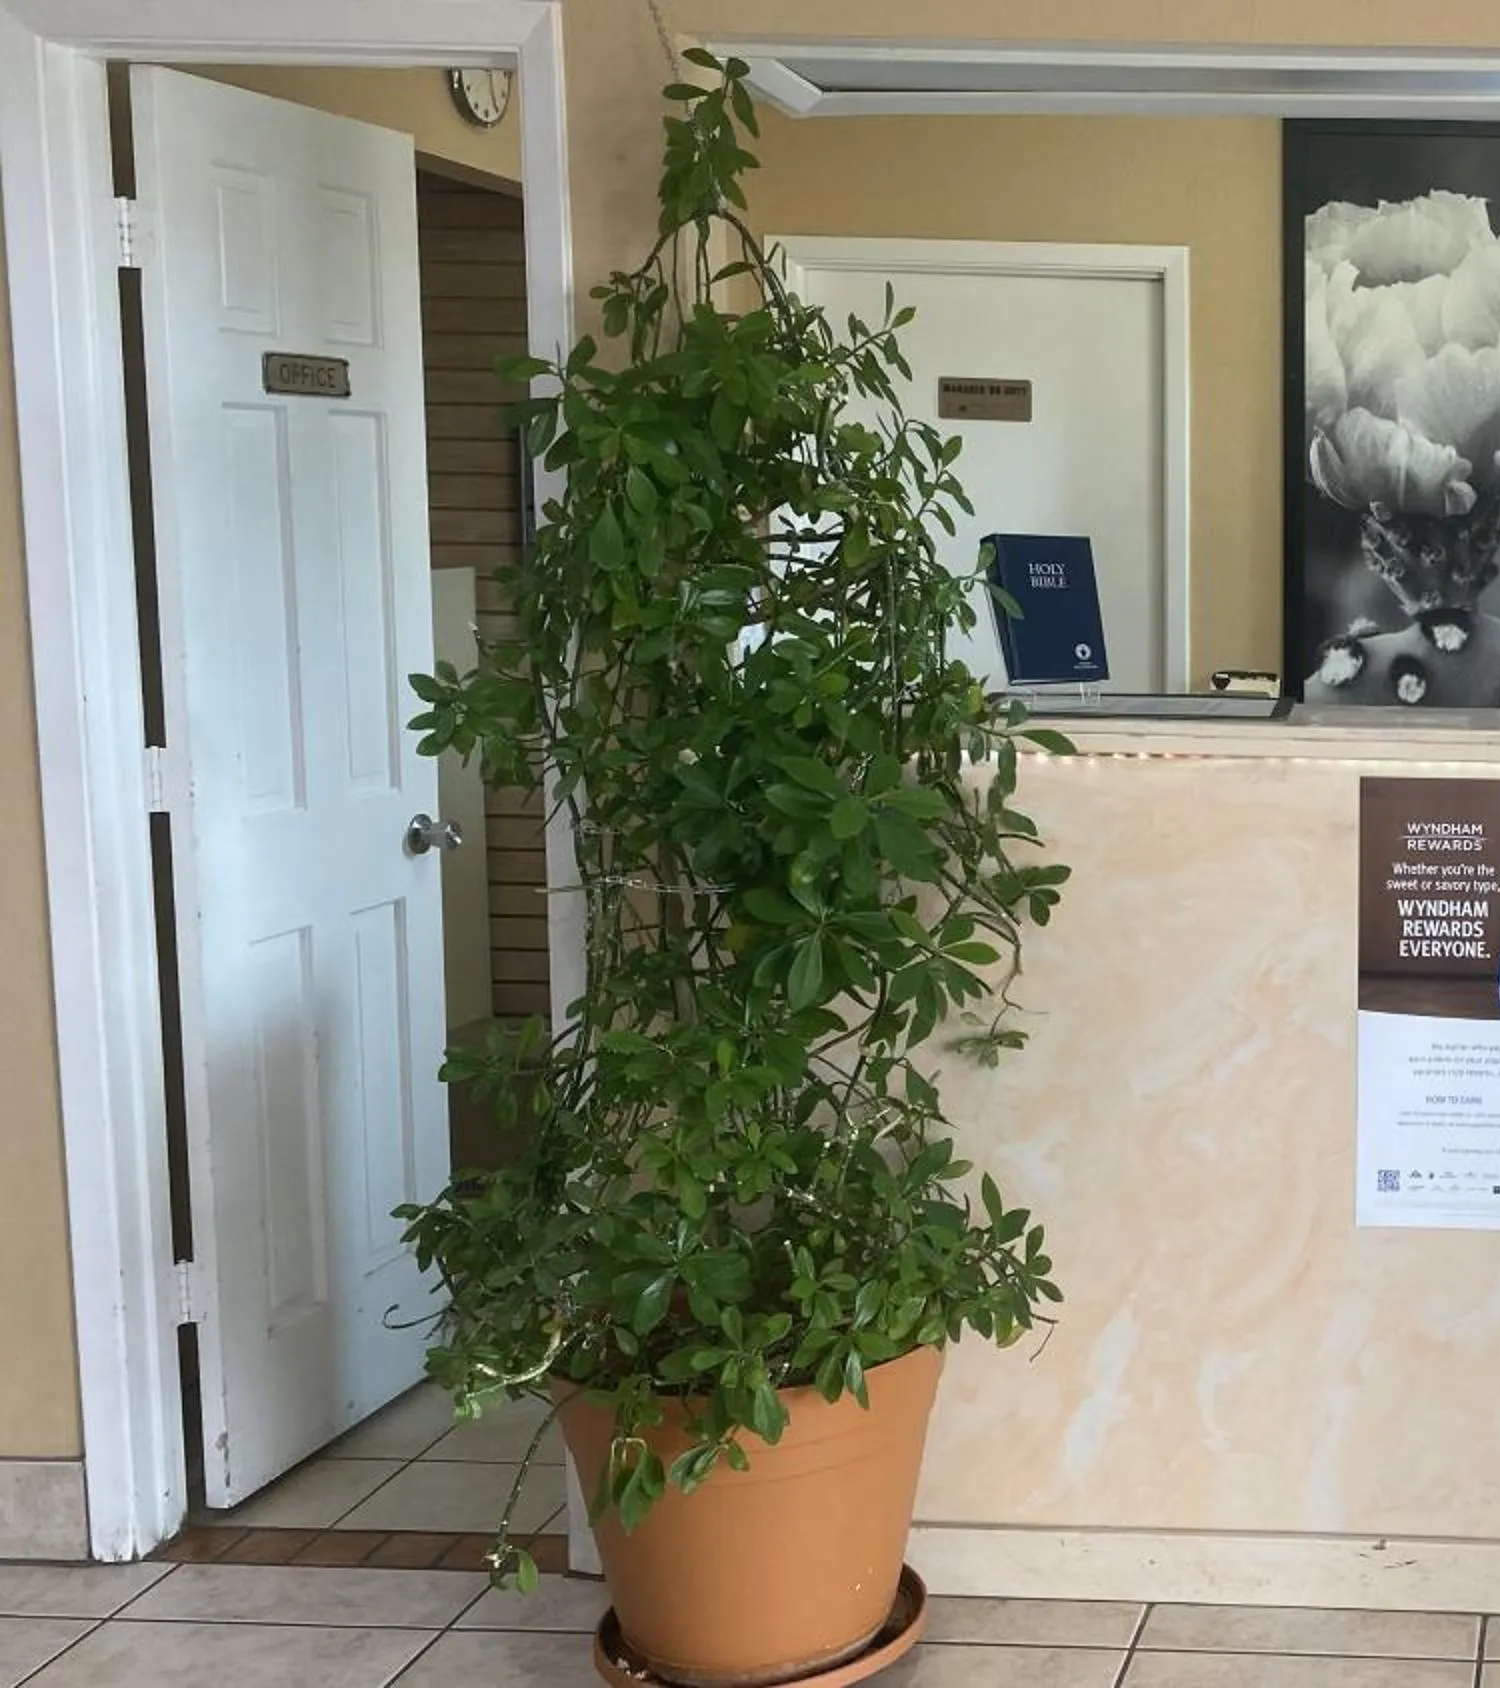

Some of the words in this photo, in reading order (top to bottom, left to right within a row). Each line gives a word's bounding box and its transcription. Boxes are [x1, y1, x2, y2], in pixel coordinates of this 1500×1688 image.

[279, 363, 337, 389] OFFICE
[1028, 562, 1066, 576] HOLY
[1030, 575, 1069, 589] BIBLE
[1406, 823, 1484, 835] WYNDHAM
[1406, 839, 1483, 851] REWARDS
[1392, 862, 1439, 876] Whether
[1441, 863, 1475, 880] you're
[1477, 863, 1496, 877] the
[1386, 879, 1419, 891] sweet
[1421, 881, 1433, 892] or
[1435, 881, 1470, 893] savory
[1397, 899, 1490, 918] WYNDHAM
[1402, 919, 1486, 938] REWARDS
[1398, 939, 1492, 959] EVERYONE.
